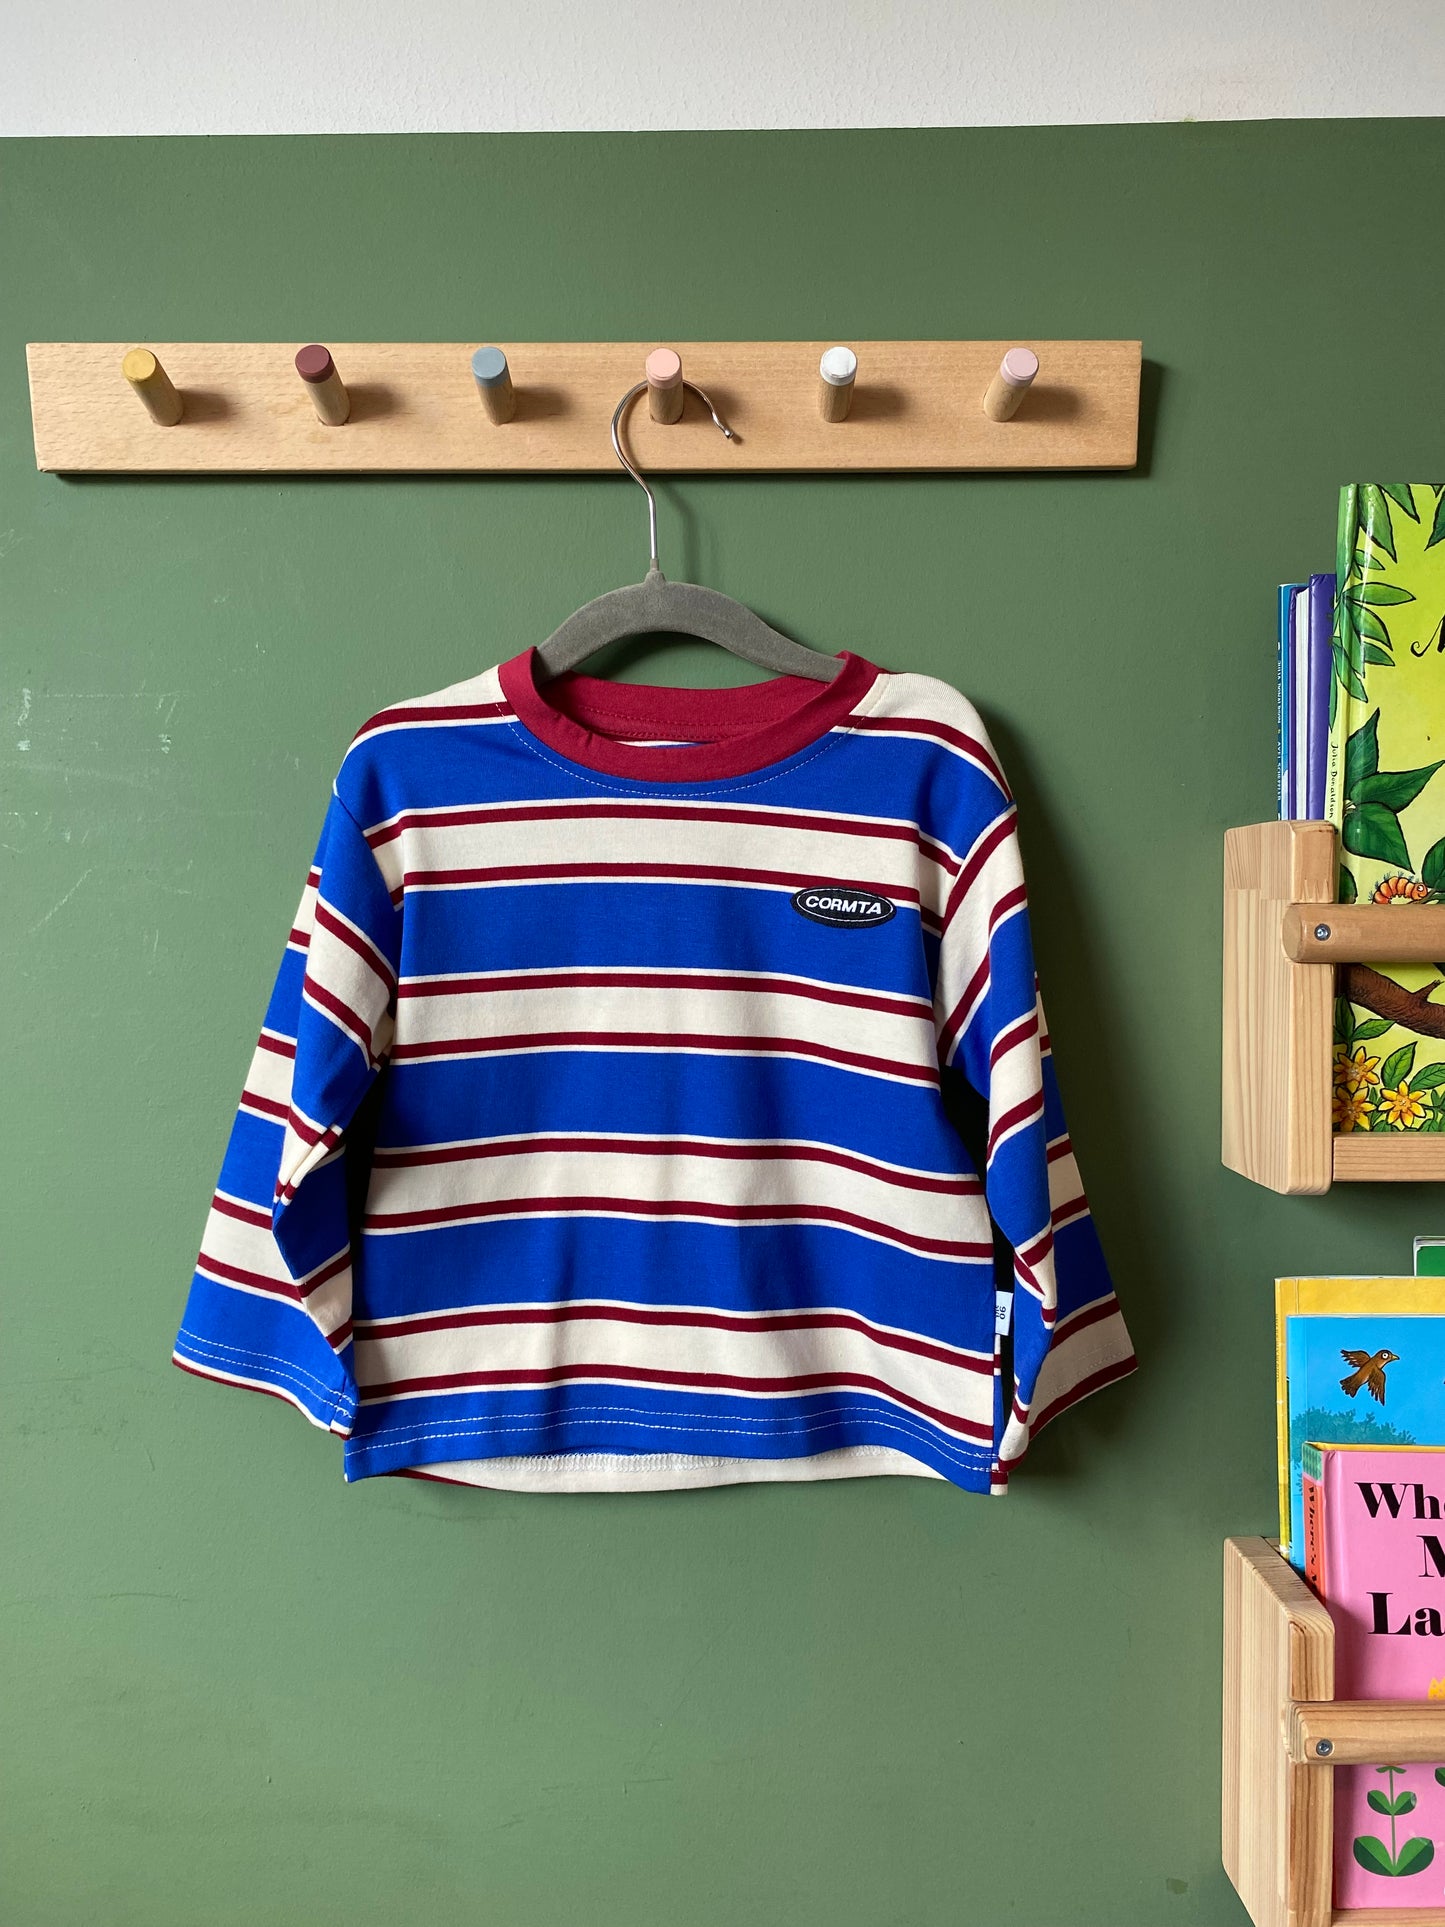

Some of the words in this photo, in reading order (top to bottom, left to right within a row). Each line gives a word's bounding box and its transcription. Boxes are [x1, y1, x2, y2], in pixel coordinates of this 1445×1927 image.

[1331, 742, 1339, 768] Julia
[1329, 770, 1338, 819] Donaldson
[805, 895, 882, 914] CORMTA
[1354, 1482, 1445, 1519] Wh
